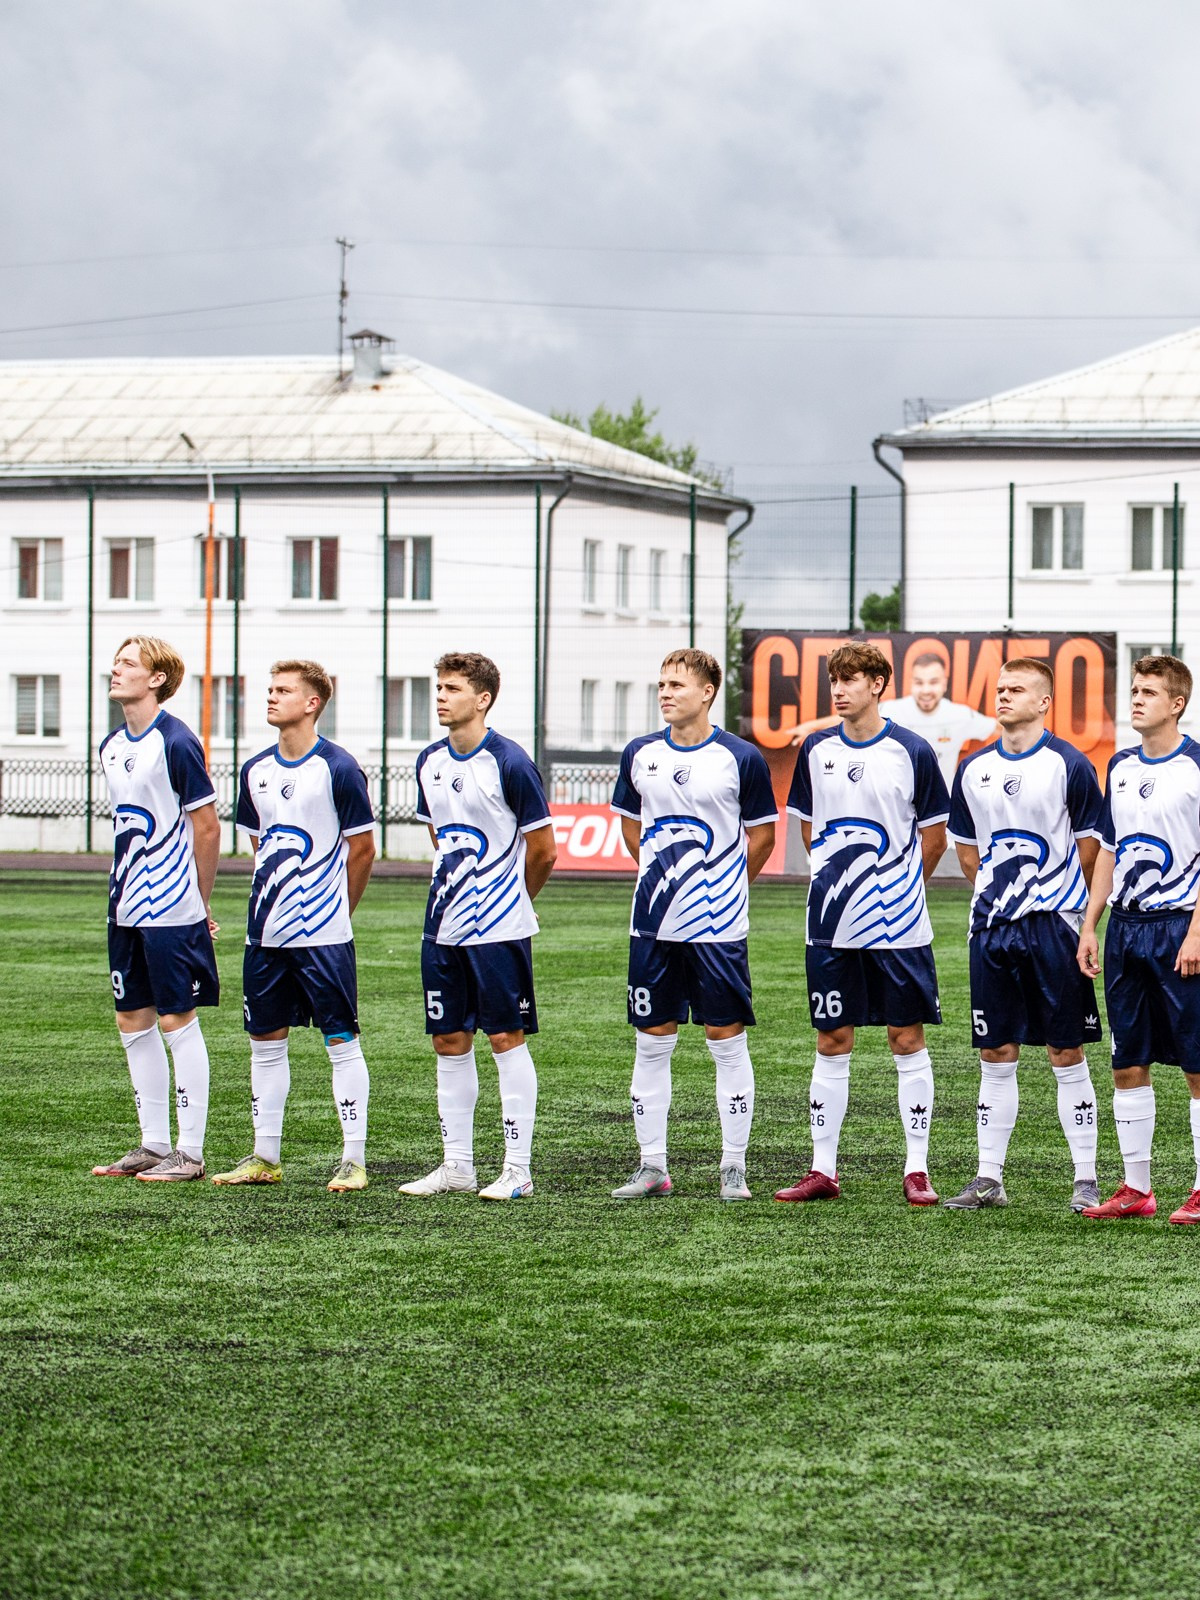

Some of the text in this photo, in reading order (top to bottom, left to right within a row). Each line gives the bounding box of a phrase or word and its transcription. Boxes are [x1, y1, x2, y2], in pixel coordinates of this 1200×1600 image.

[752, 636, 1105, 754] СПСИО
[427, 990, 444, 1020] 5
[811, 990, 843, 1019] 26
[972, 1009, 988, 1036] 5
[341, 1109, 357, 1121] 55
[729, 1102, 748, 1115] 38
[1075, 1112, 1093, 1125] 95
[911, 1117, 927, 1130] 26
